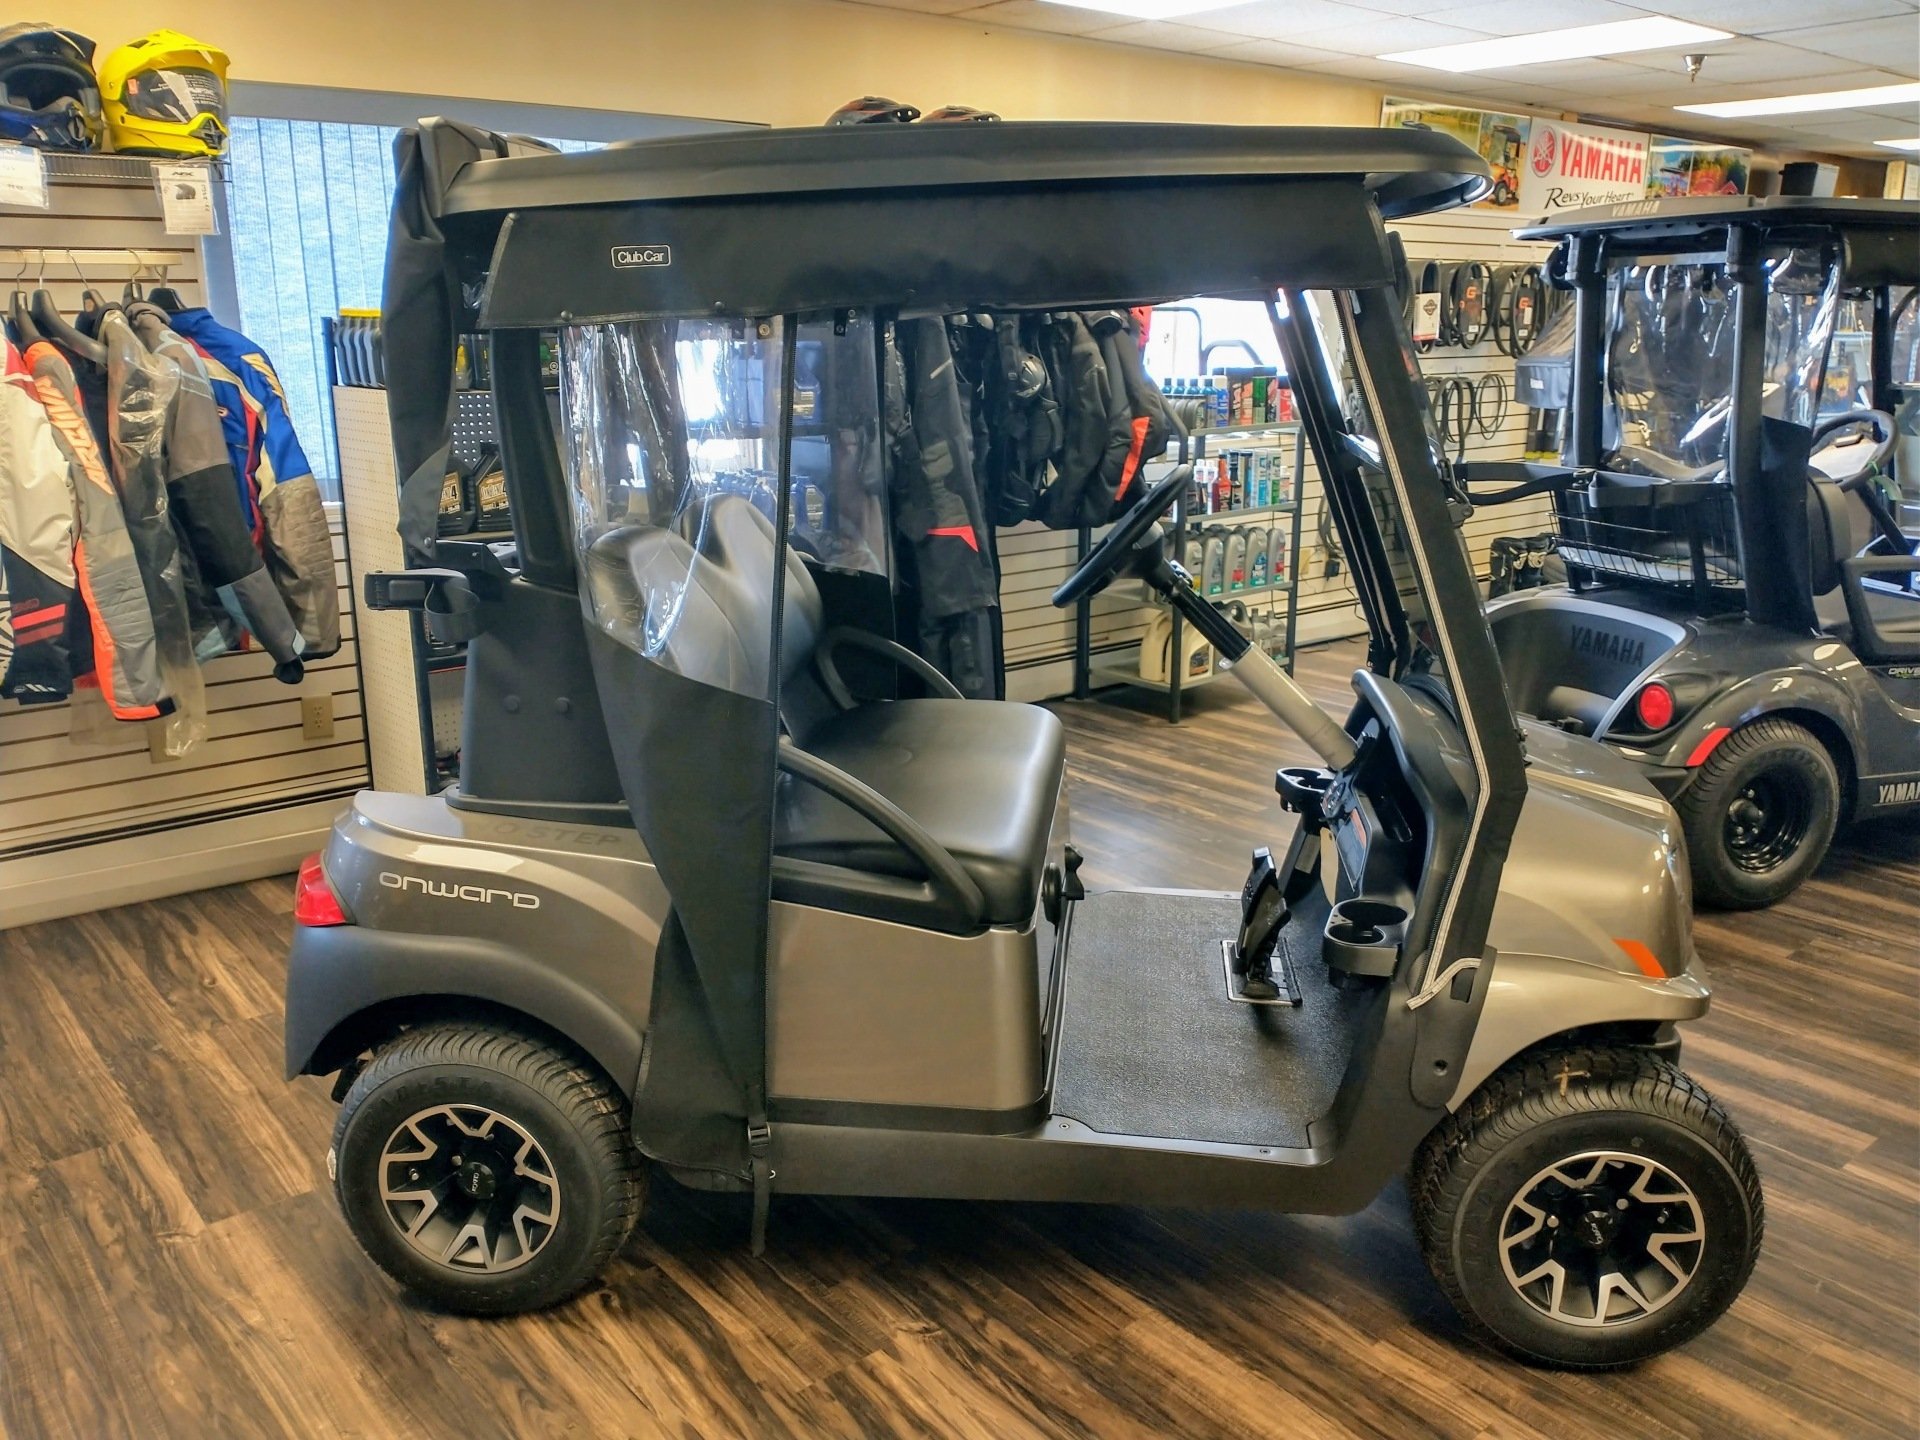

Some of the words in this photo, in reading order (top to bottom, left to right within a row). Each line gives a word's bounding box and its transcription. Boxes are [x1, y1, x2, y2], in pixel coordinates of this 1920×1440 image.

[1560, 131, 1643, 184] YAMAHA
[1544, 187, 1581, 210] Revs
[1580, 191, 1604, 209] Your
[1604, 190, 1631, 204] Heart
[1611, 200, 1660, 217] YAMAHA
[1571, 624, 1645, 668] YAMAHA
[526, 826, 622, 846] STEP
